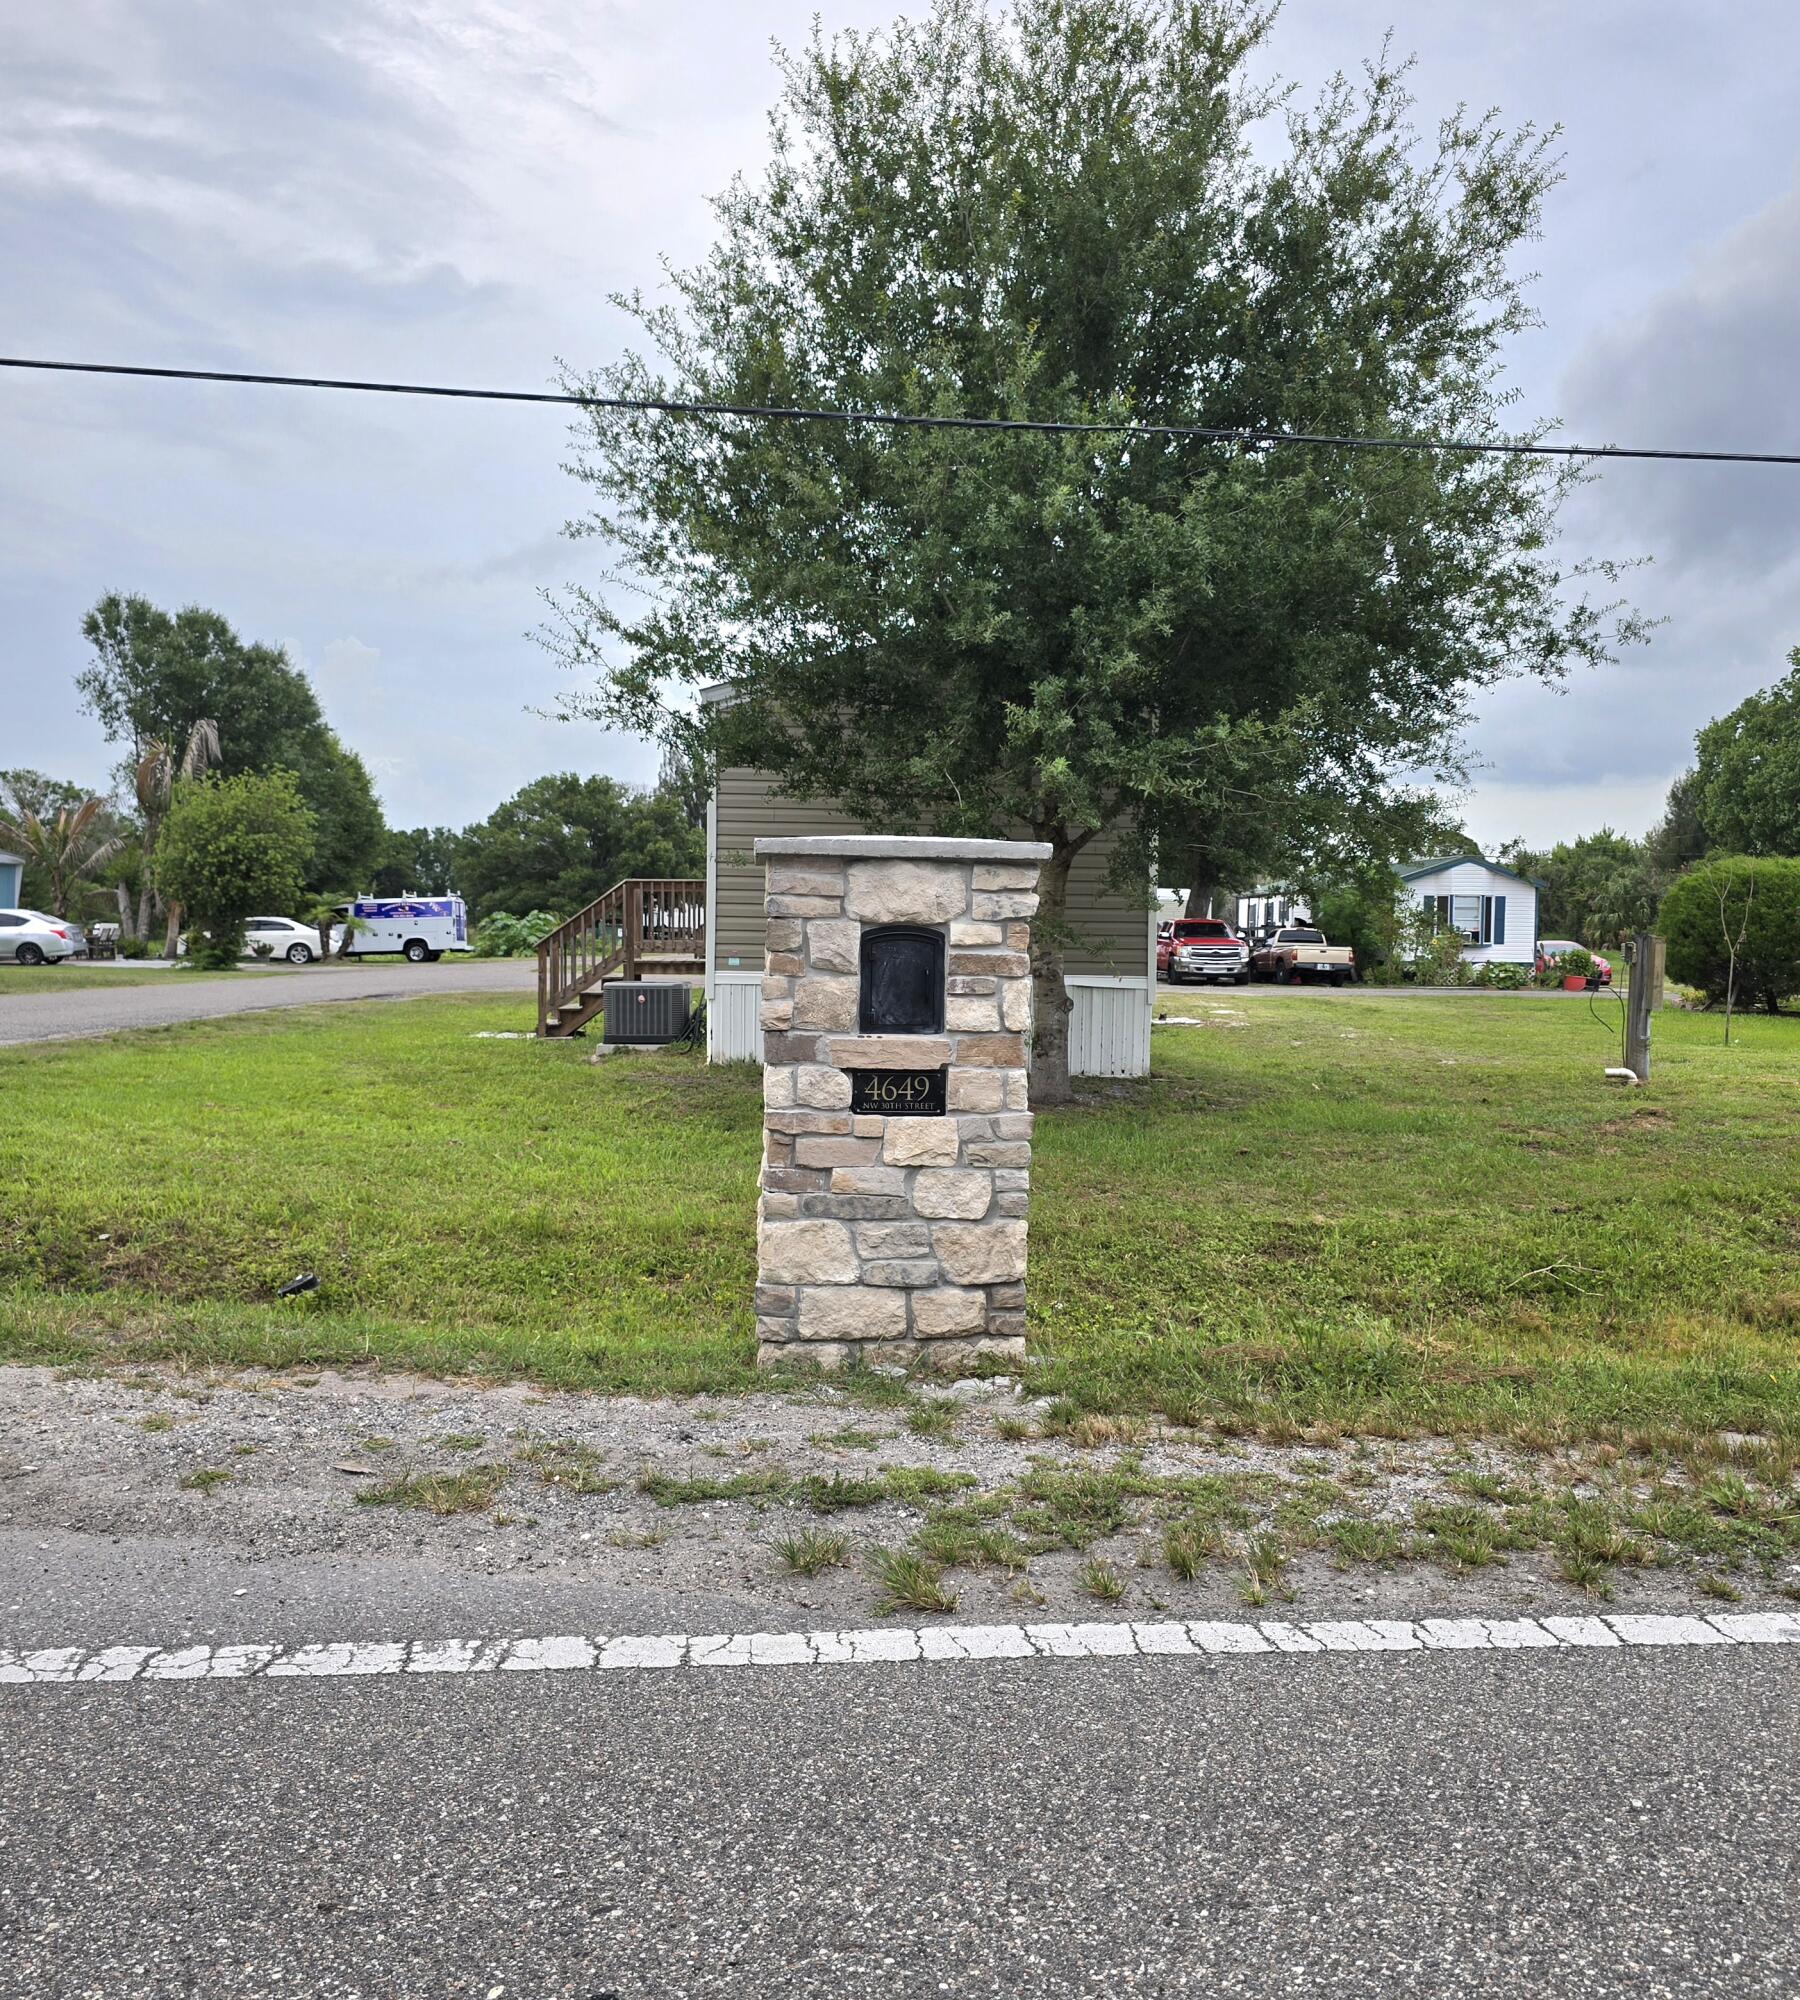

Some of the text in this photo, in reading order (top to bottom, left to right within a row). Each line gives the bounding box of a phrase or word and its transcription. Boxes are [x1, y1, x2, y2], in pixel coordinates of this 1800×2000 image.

[864, 1075, 930, 1101] 4649
[862, 1102, 935, 1110] NW 30TH STREET
